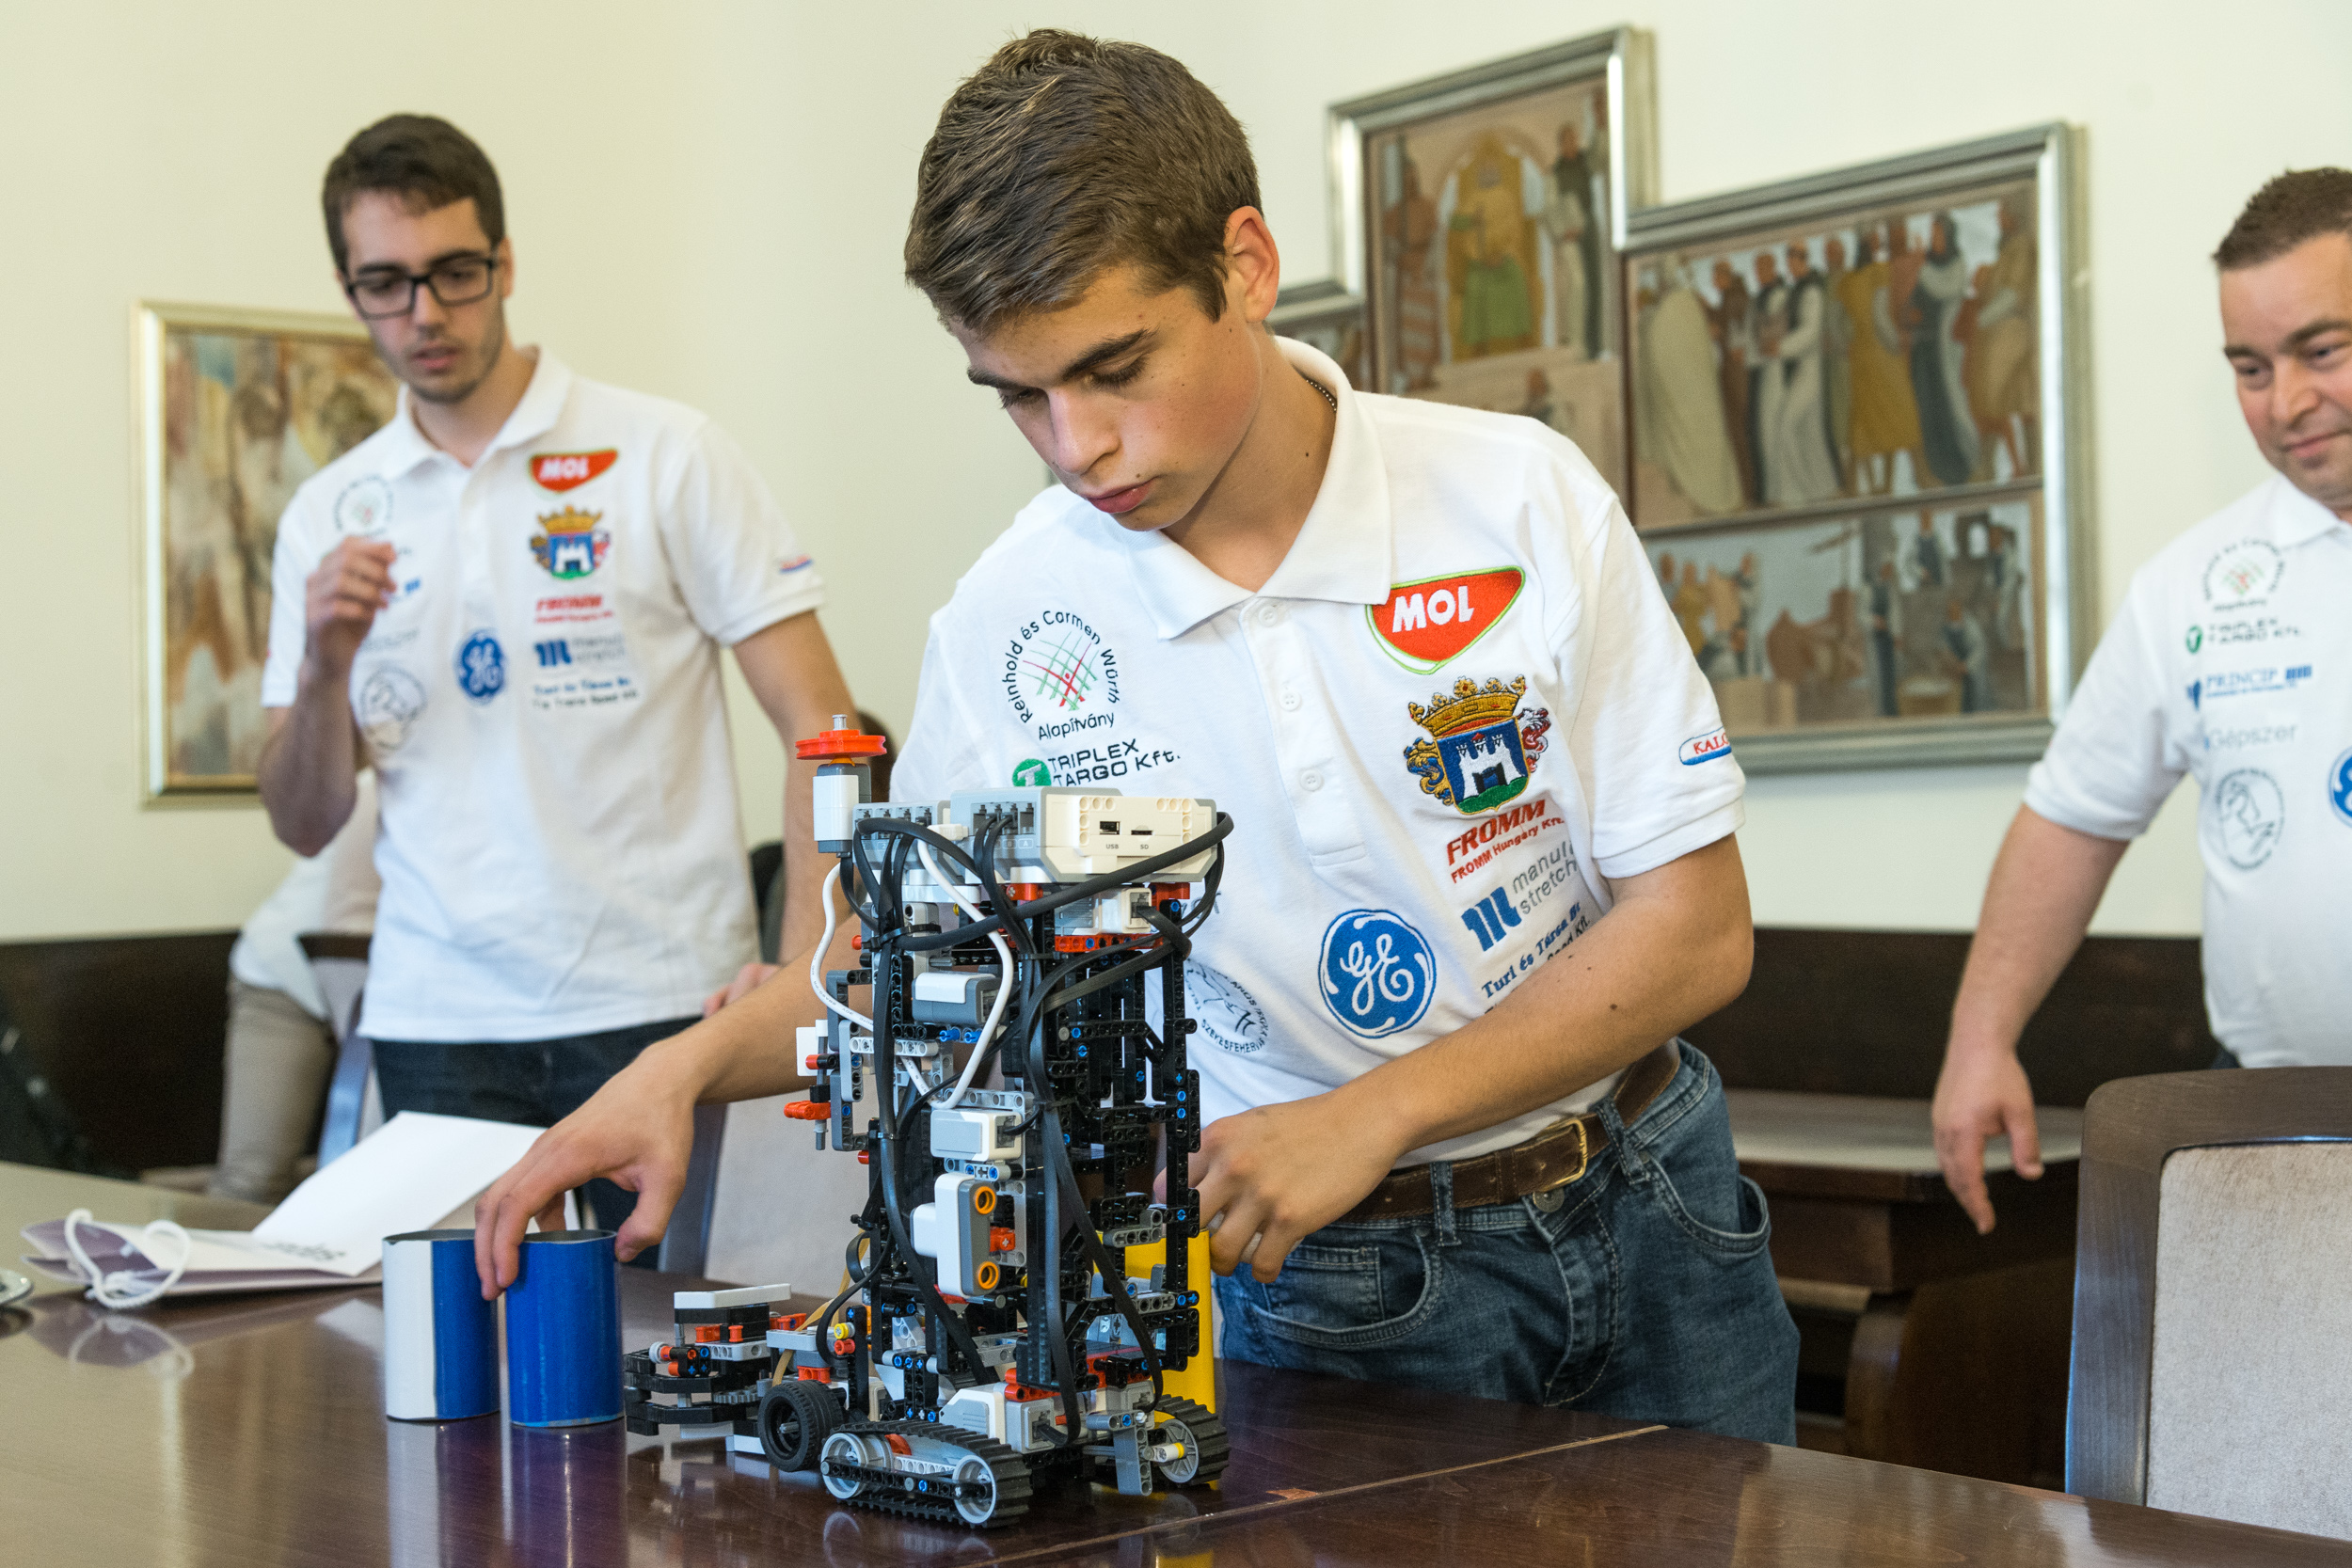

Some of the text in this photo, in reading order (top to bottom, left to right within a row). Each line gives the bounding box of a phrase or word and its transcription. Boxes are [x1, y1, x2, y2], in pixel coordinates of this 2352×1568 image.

[538, 456, 589, 481] MOL
[1392, 585, 1474, 633] MOL
[1002, 610, 1120, 723] Reinhold és Carmen Würth
[1039, 712, 1114, 740] Alapítvány
[1048, 738, 1139, 773] TRIPLEX
[1054, 751, 1181, 787] TARGO Kft.
[1447, 799, 1546, 867] FROMM
[1451, 849, 1493, 884] FROMM
[1493, 825, 1539, 856] Hungary
[1519, 859, 1578, 915] stretch
[1519, 954, 1534, 971] és
